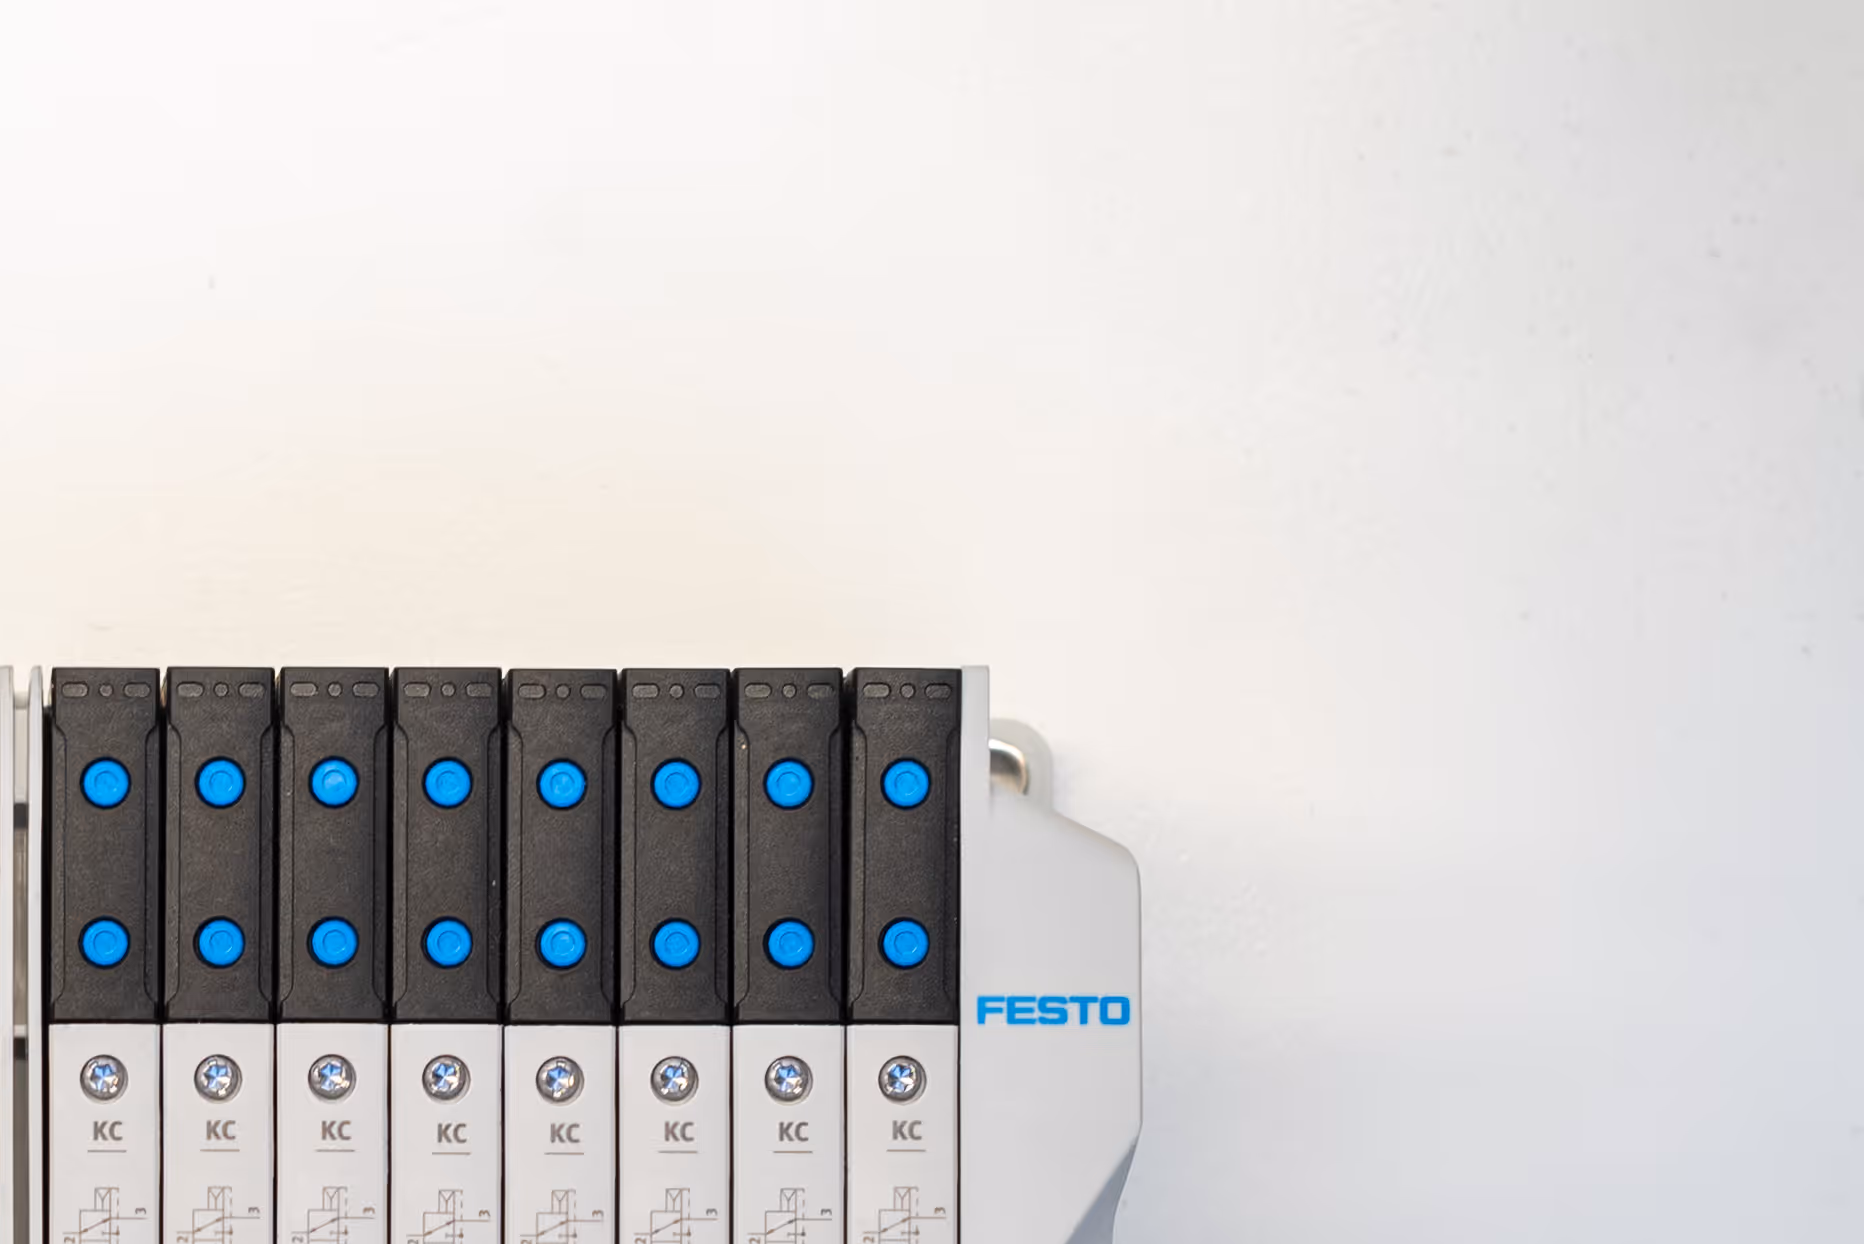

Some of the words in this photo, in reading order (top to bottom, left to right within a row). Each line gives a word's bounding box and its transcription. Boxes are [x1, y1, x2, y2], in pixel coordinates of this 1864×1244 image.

[977, 996, 1130, 1026] FESTO
[92, 1120, 123, 1142] KC
[205, 1119, 236, 1141] KC
[320, 1120, 351, 1142] KC
[436, 1122, 467, 1144] KC
[549, 1122, 580, 1144] KC
[663, 1121, 694, 1143] KC
[778, 1121, 809, 1143] KC
[891, 1120, 922, 1142] KC
[135, 1207, 147, 1215] 3
[248, 1206, 260, 1214] 3
[363, 1206, 375, 1214] 3
[478, 1210, 490, 1218] 3
[592, 1210, 604, 1218] 3
[706, 1208, 718, 1216] 3
[820, 1208, 832, 1216] 3
[934, 1206, 946, 1214] 3
[63, 1236, 75, 1244] 2
[176, 1235, 188, 1244] 2
[291, 1236, 303, 1244] 2
[862, 1236, 874, 1244] 2
